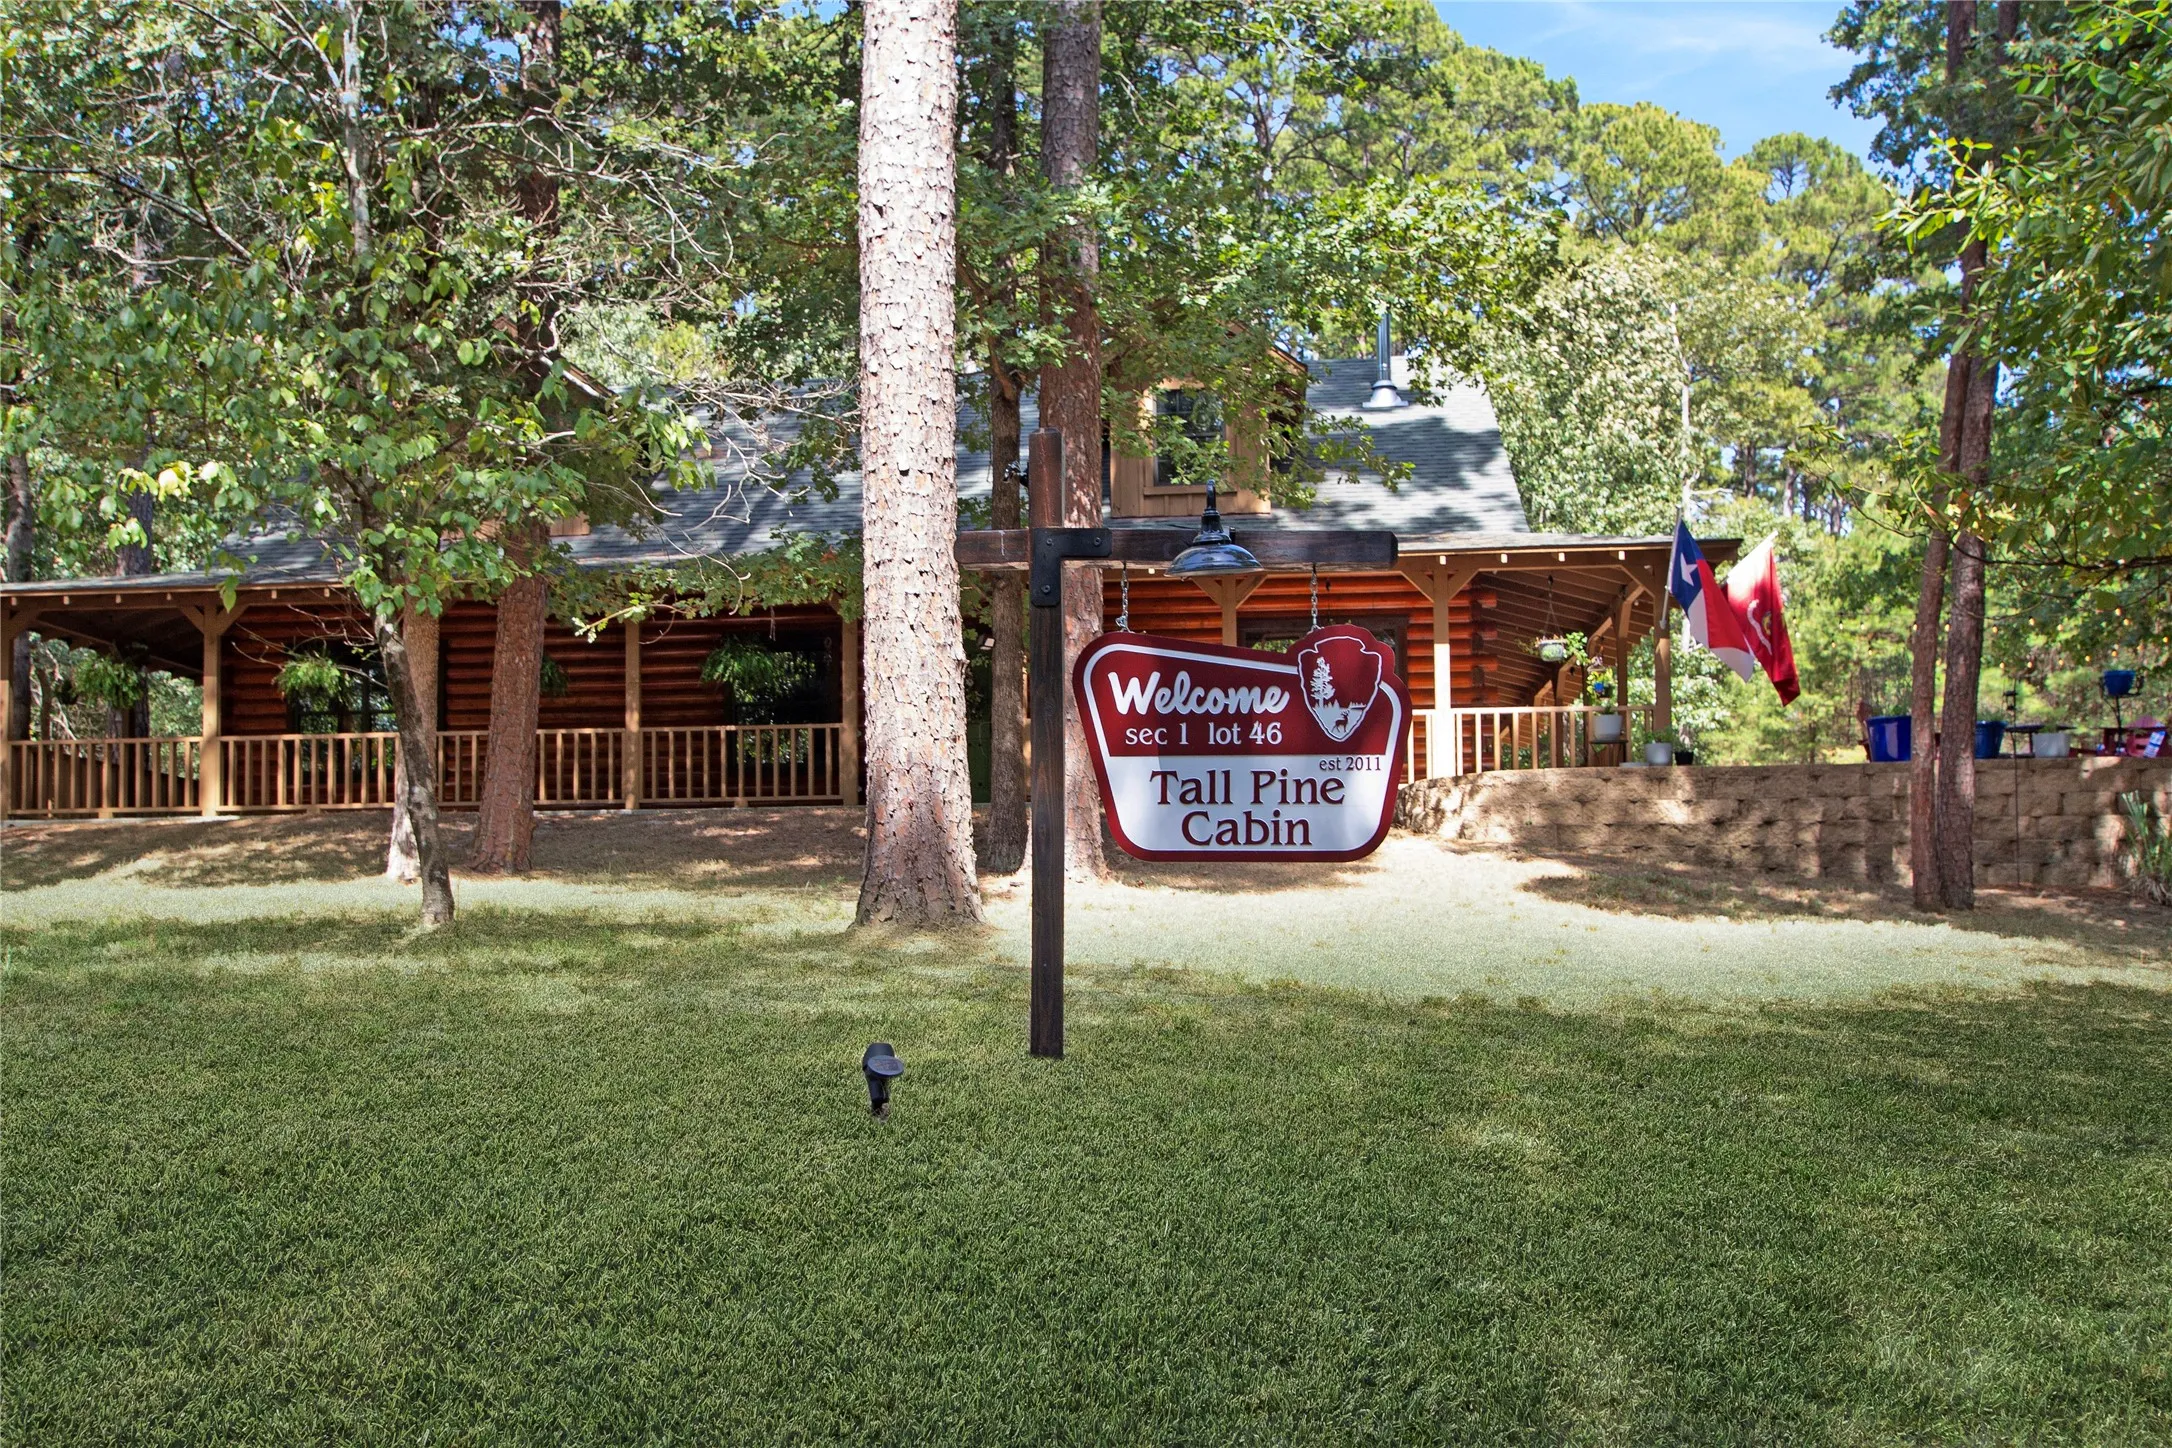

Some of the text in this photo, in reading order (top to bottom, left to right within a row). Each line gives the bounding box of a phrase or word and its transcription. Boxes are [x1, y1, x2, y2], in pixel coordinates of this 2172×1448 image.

[1107, 670, 1290, 715] Welcome
[1125, 726, 1168, 745] sec
[1208, 721, 1241, 745] lot
[1249, 722, 1283, 744] 46
[1319, 756, 1381, 771] est 2011
[1149, 768, 1346, 805] Tall Pine
[1181, 808, 1312, 847] Cabin
